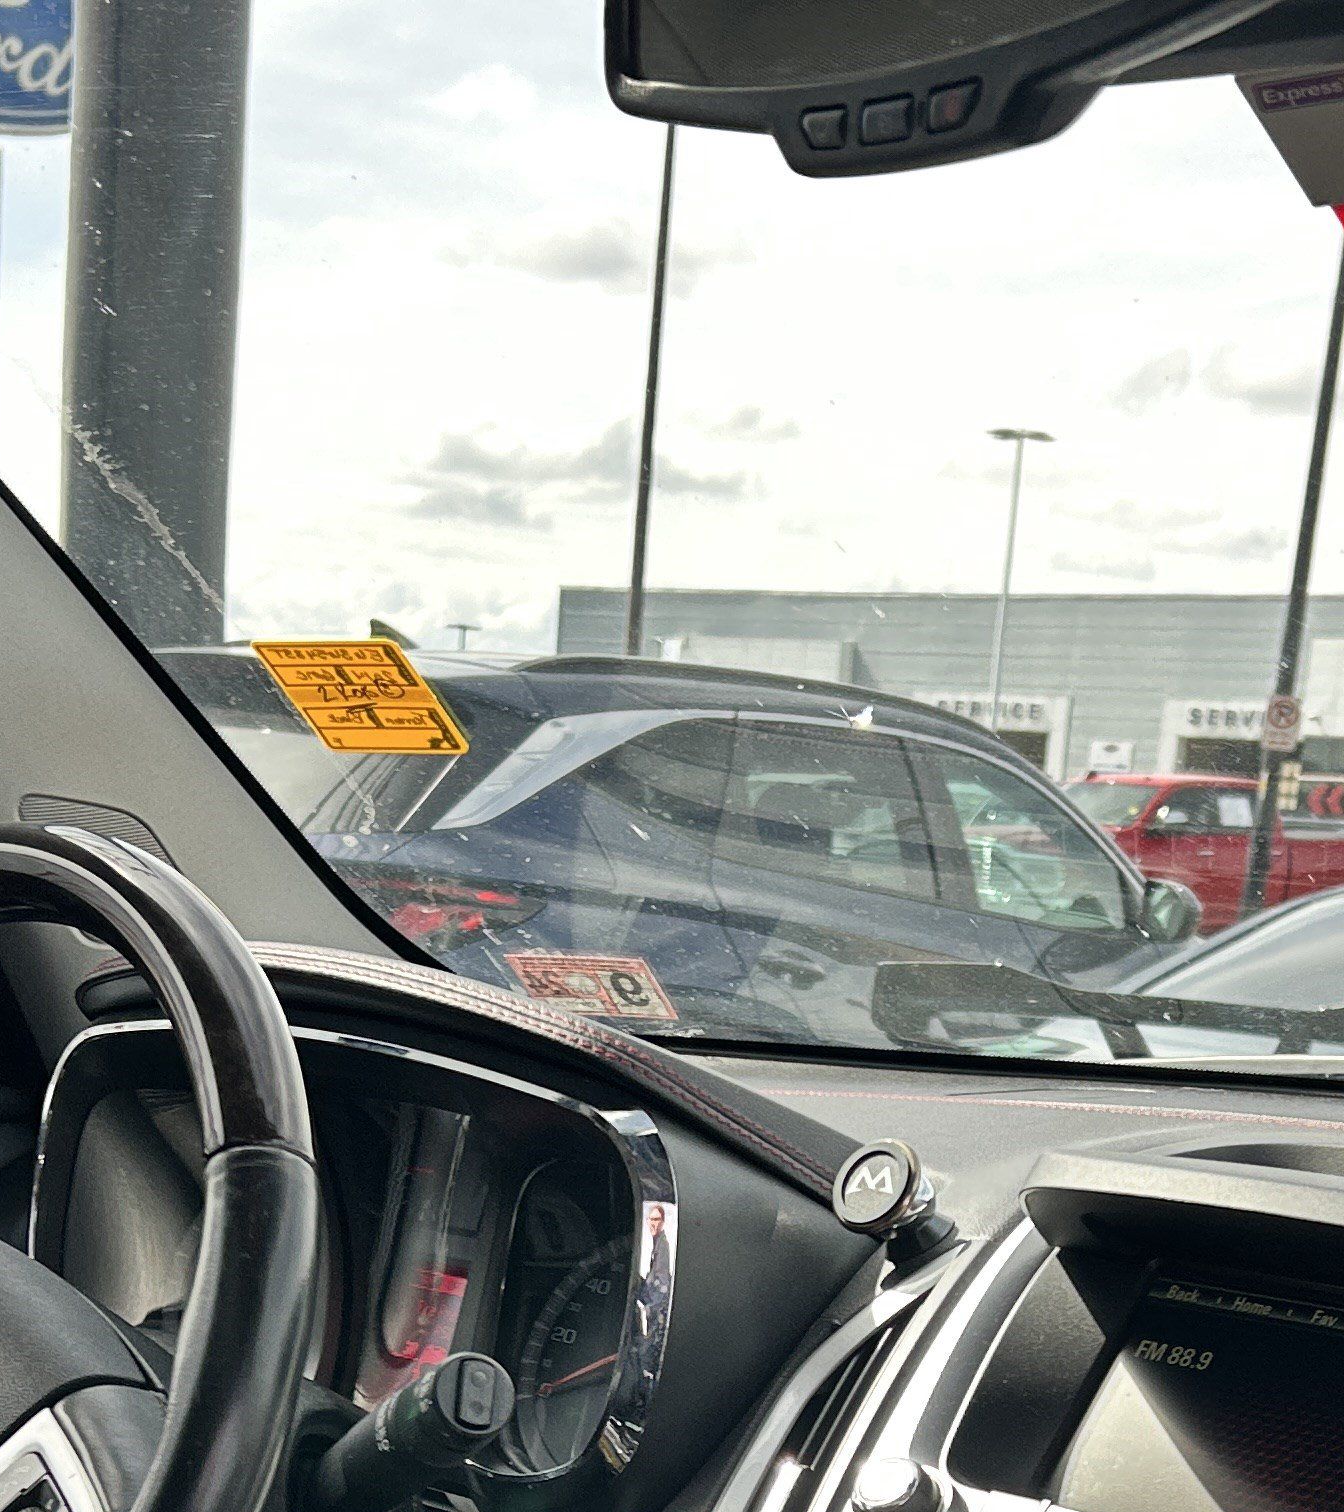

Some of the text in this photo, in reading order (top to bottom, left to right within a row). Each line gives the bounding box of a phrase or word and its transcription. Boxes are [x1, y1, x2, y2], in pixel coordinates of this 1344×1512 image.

[587, 1279, 611, 1295] 40
[1166, 1284, 1339, 1327] Back Home Fav
[550, 1326, 577, 1344] 20
[1134, 1339, 1214, 1370] FM 88.9
